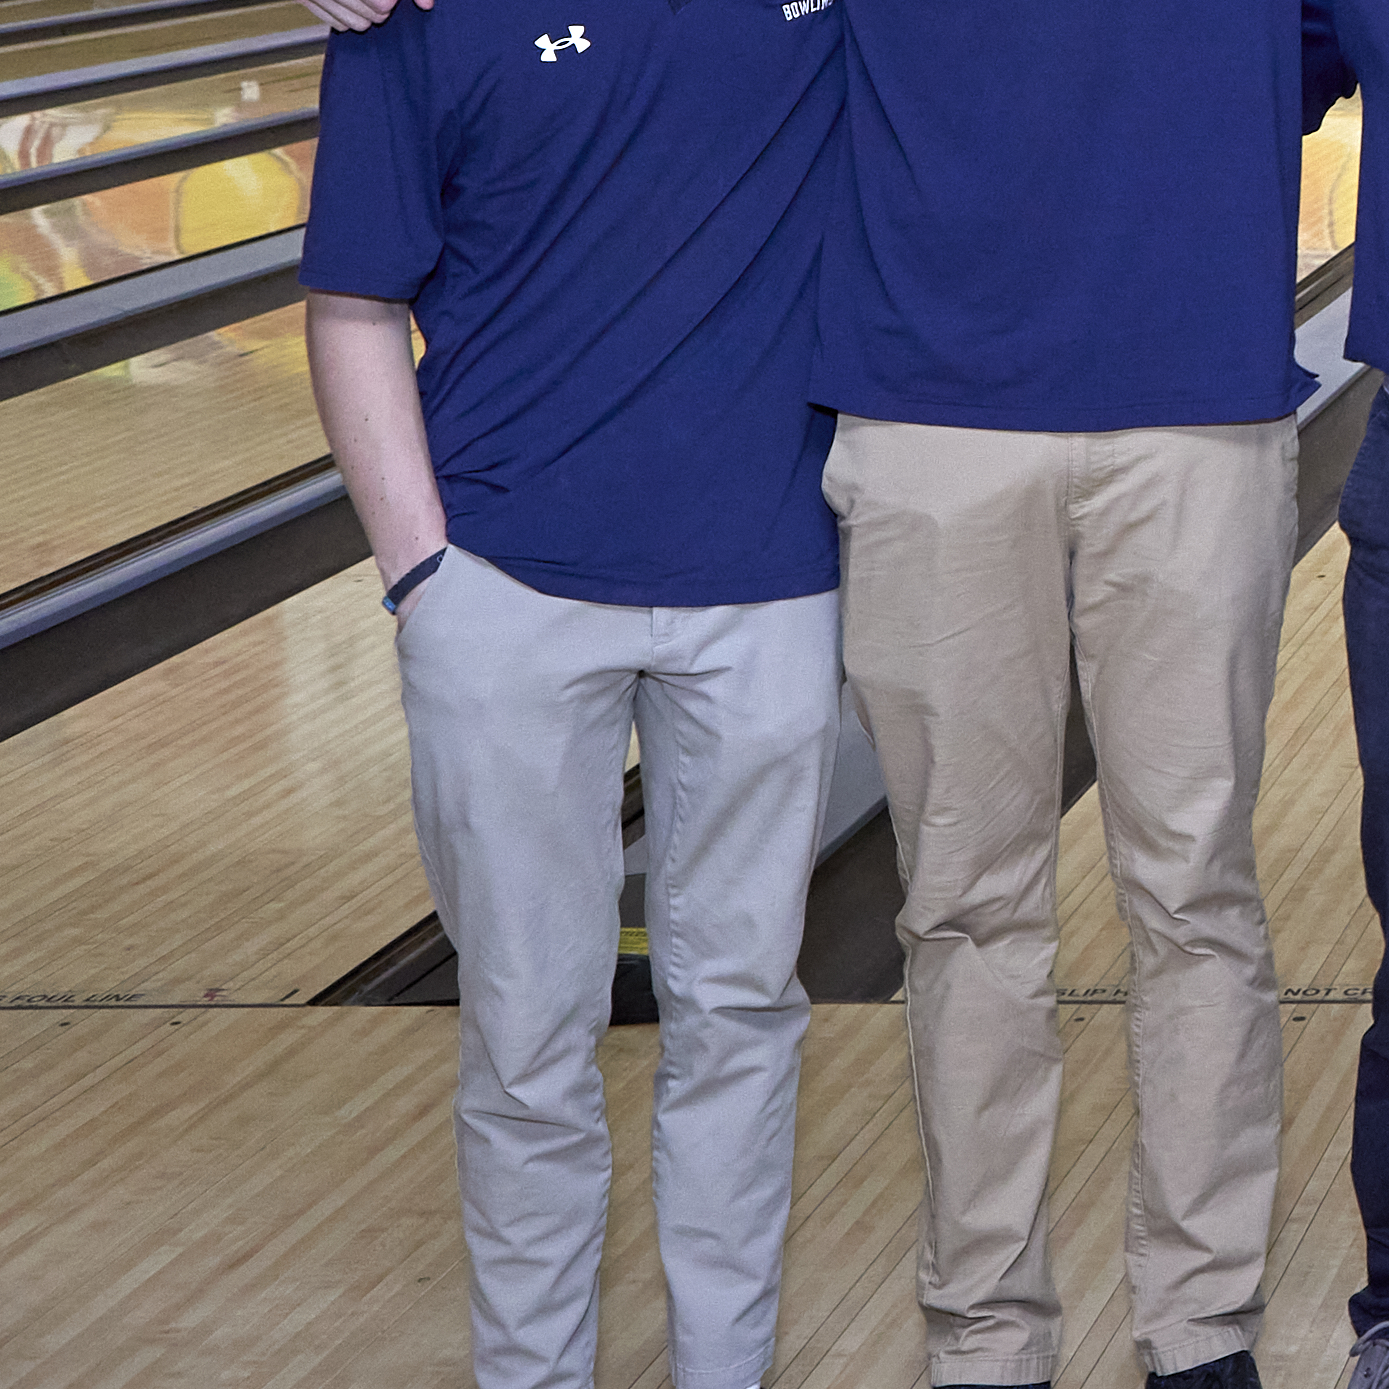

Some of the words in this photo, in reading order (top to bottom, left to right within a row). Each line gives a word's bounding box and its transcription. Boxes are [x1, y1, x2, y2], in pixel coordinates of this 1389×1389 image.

[1284, 987, 1338, 997] NOT
[9, 994, 76, 1003] FOUL
[83, 993, 146, 1002] LINE
